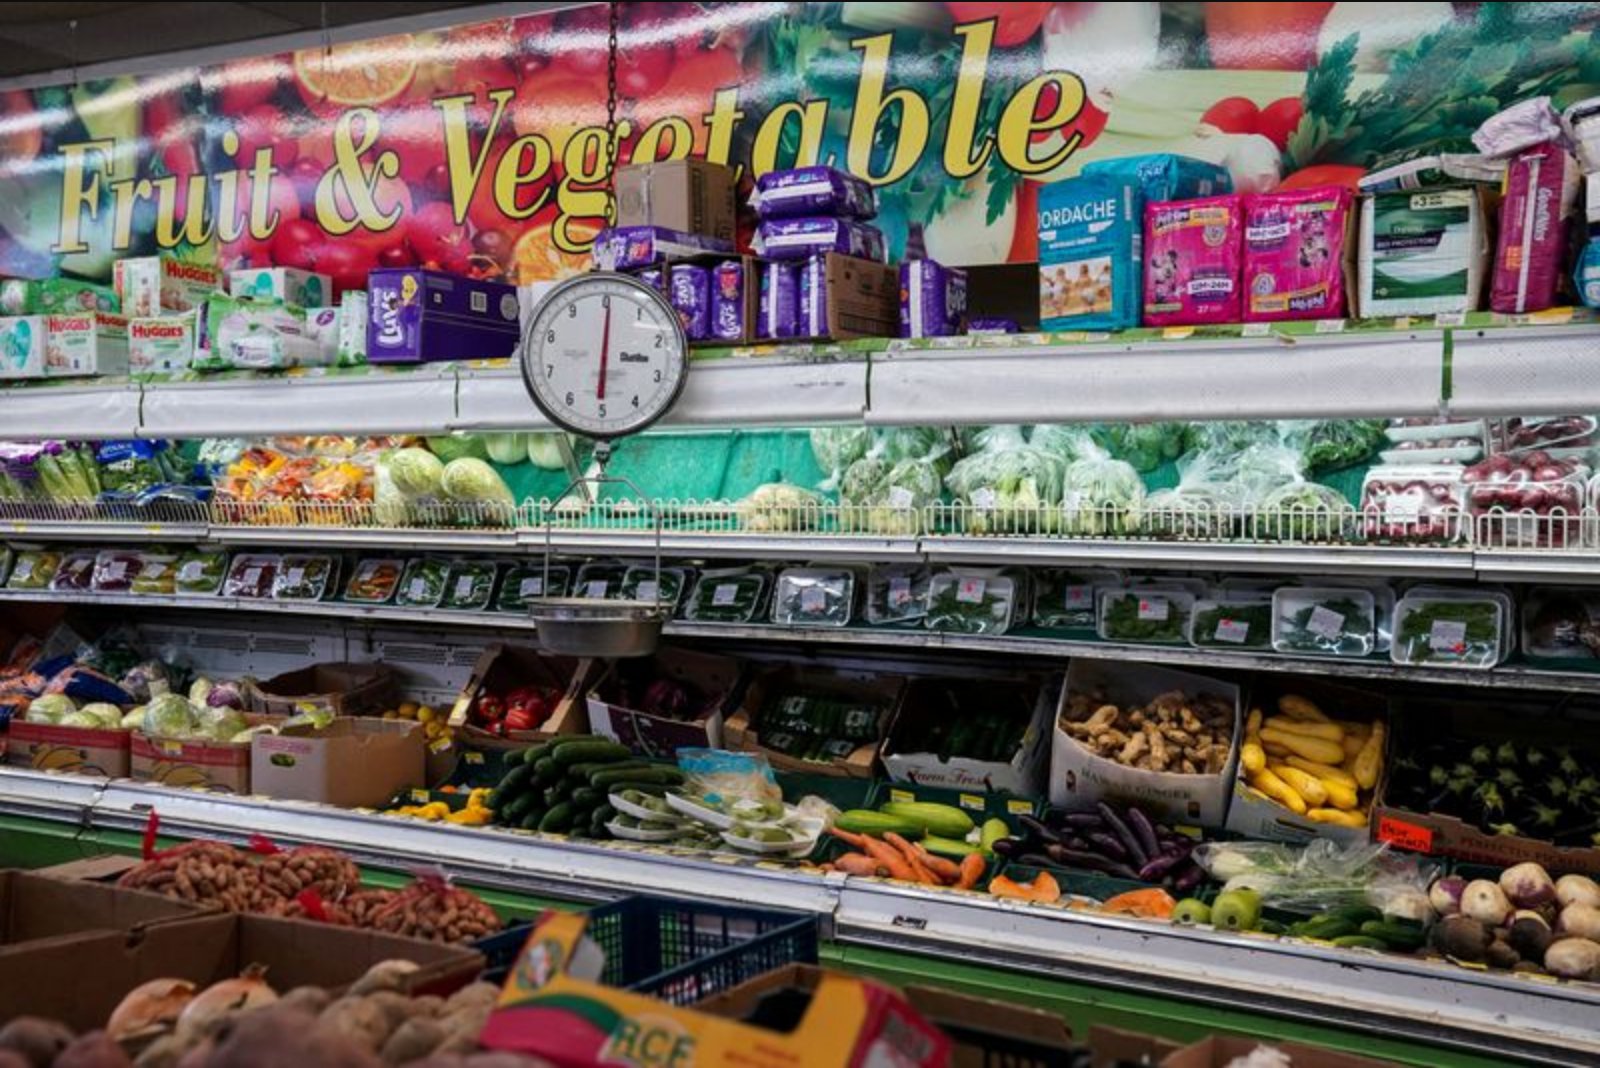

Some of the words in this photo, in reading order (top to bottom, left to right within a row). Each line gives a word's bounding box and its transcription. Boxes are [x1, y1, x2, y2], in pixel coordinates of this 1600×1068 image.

[50, 131, 280, 254] Fruit
[314, 106, 401, 236] &
[166, 258, 216, 285] HUGGIES
[568, 304, 577, 318] 9
[637, 308, 642, 321] 1
[48, 317, 91, 333] HUGGIES
[132, 324, 184, 338] HUGGIES
[547, 330, 555, 343] 8
[654, 335, 663, 348] 2
[546, 365, 554, 379] 7
[654, 369, 661, 383] 3
[565, 392, 574, 406] 6
[631, 395, 639, 408] 4
[600, 404, 607, 418] 5
